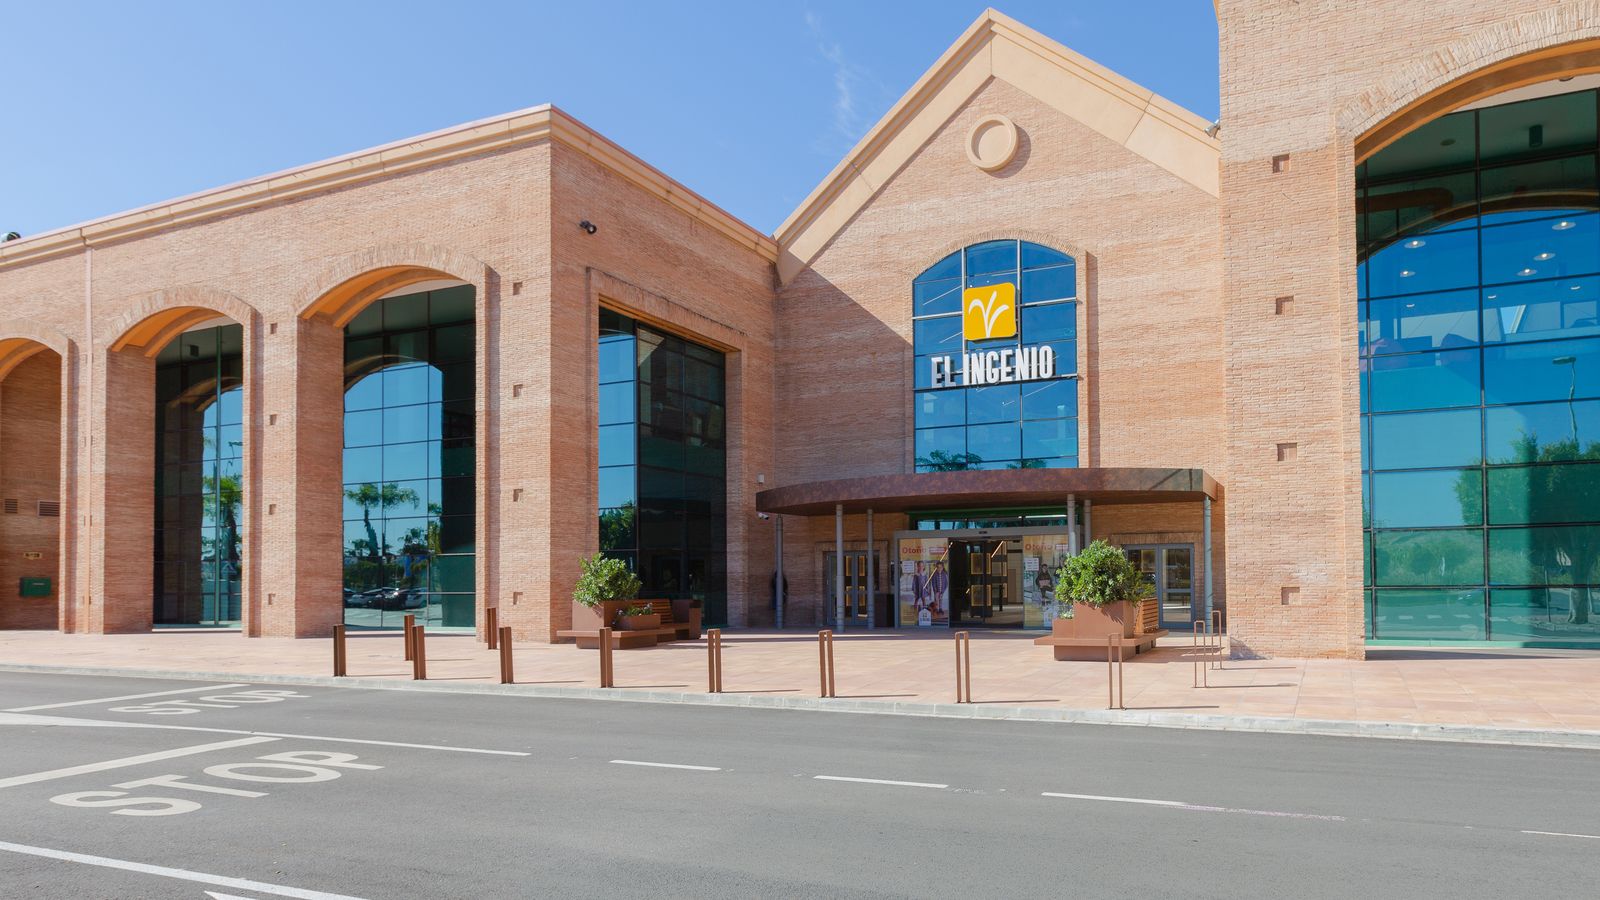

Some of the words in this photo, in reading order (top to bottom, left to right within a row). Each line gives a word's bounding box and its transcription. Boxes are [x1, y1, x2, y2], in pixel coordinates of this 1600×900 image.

[931, 356, 956, 388] EL
[963, 345, 1053, 386] INGENIO
[108, 689, 311, 715] STOP
[49, 750, 384, 816] STOP
